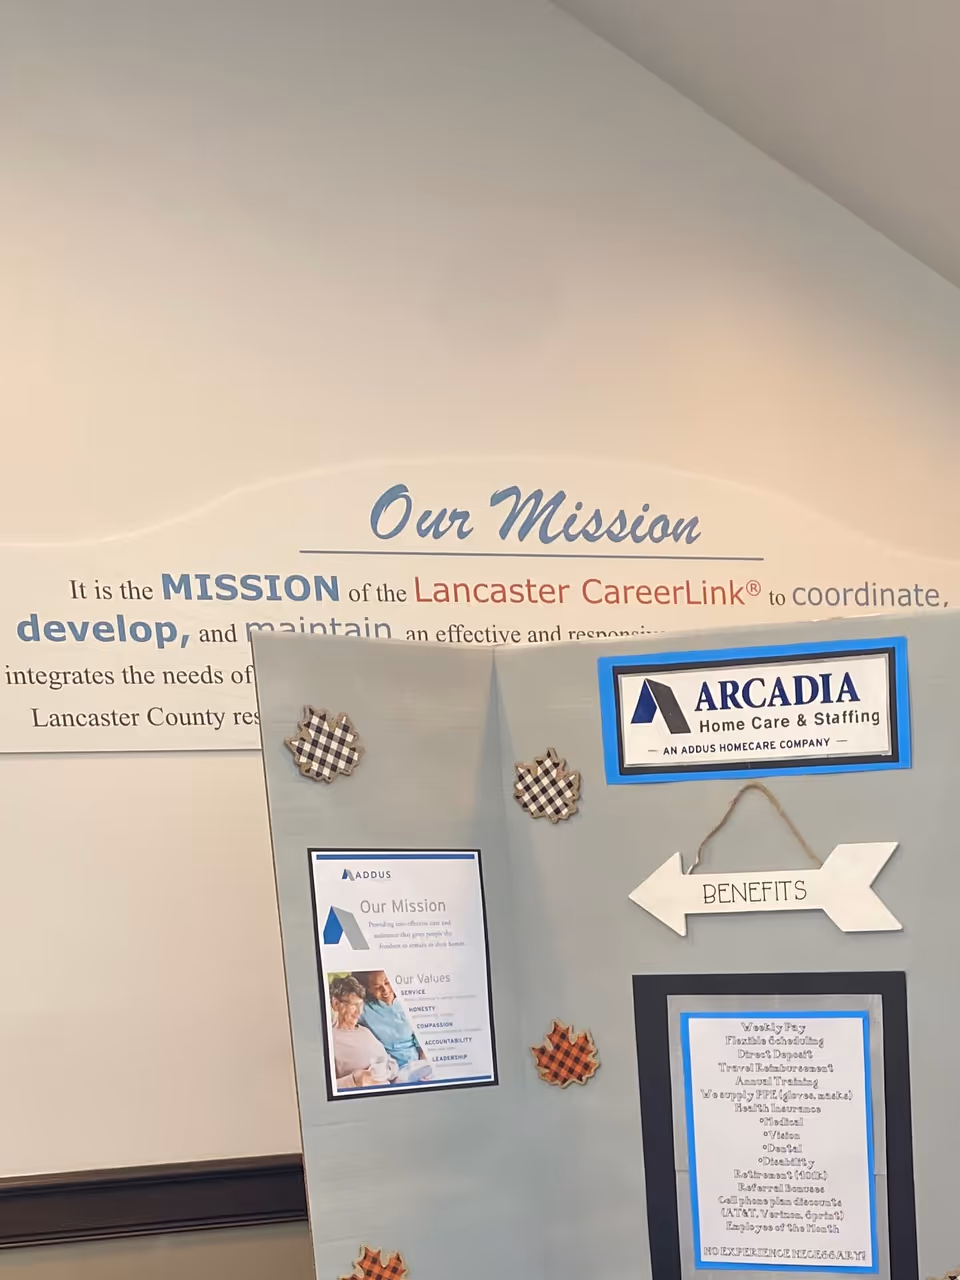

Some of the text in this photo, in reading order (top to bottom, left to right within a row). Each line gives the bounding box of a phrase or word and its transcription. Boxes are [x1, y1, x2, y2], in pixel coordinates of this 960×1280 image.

[369, 484, 701, 544] Our Mission
[69, 580, 87, 599] It
[95, 580, 112, 599] is
[120, 580, 153, 599] the
[161, 573, 339, 601] MISSION
[349, 584, 373, 602] of
[377, 584, 407, 602] the
[415, 576, 569, 603] Lancaster
[769, 590, 785, 606] to
[792, 581, 948, 608] coordinate,
[16, 614, 190, 649] develop,
[199, 623, 237, 642] and
[406, 629, 428, 641] an
[436, 624, 521, 643] effective
[528, 625, 561, 642] and
[5, 666, 255, 689] integrates the needs of
[694, 671, 861, 711] ARCADIA
[31, 708, 139, 729] Lancaster
[147, 707, 225, 730] County
[700, 710, 880, 733] Home Care & Staffing
[663, 738, 830, 755] AN ADDUS HOMECARE COMPANY
[355, 871, 391, 879] ADDUS
[703, 880, 807, 904] BENEFITS
[360, 899, 446, 913] Our Mission
[395, 974, 450, 984] Our Values
[741, 1022, 806, 1034] Weekly Pay
[425, 1037, 472, 1045] ACCOUNTABILITY
[725, 1035, 824, 1048] Flexible Scheduling
[738, 1050, 813, 1061] Direct Deposit
[718, 1063, 834, 1073] Travel Reimbursement
[704, 1247, 719, 1256] NO
[720, 1247, 790, 1258] EXPERIENCE
